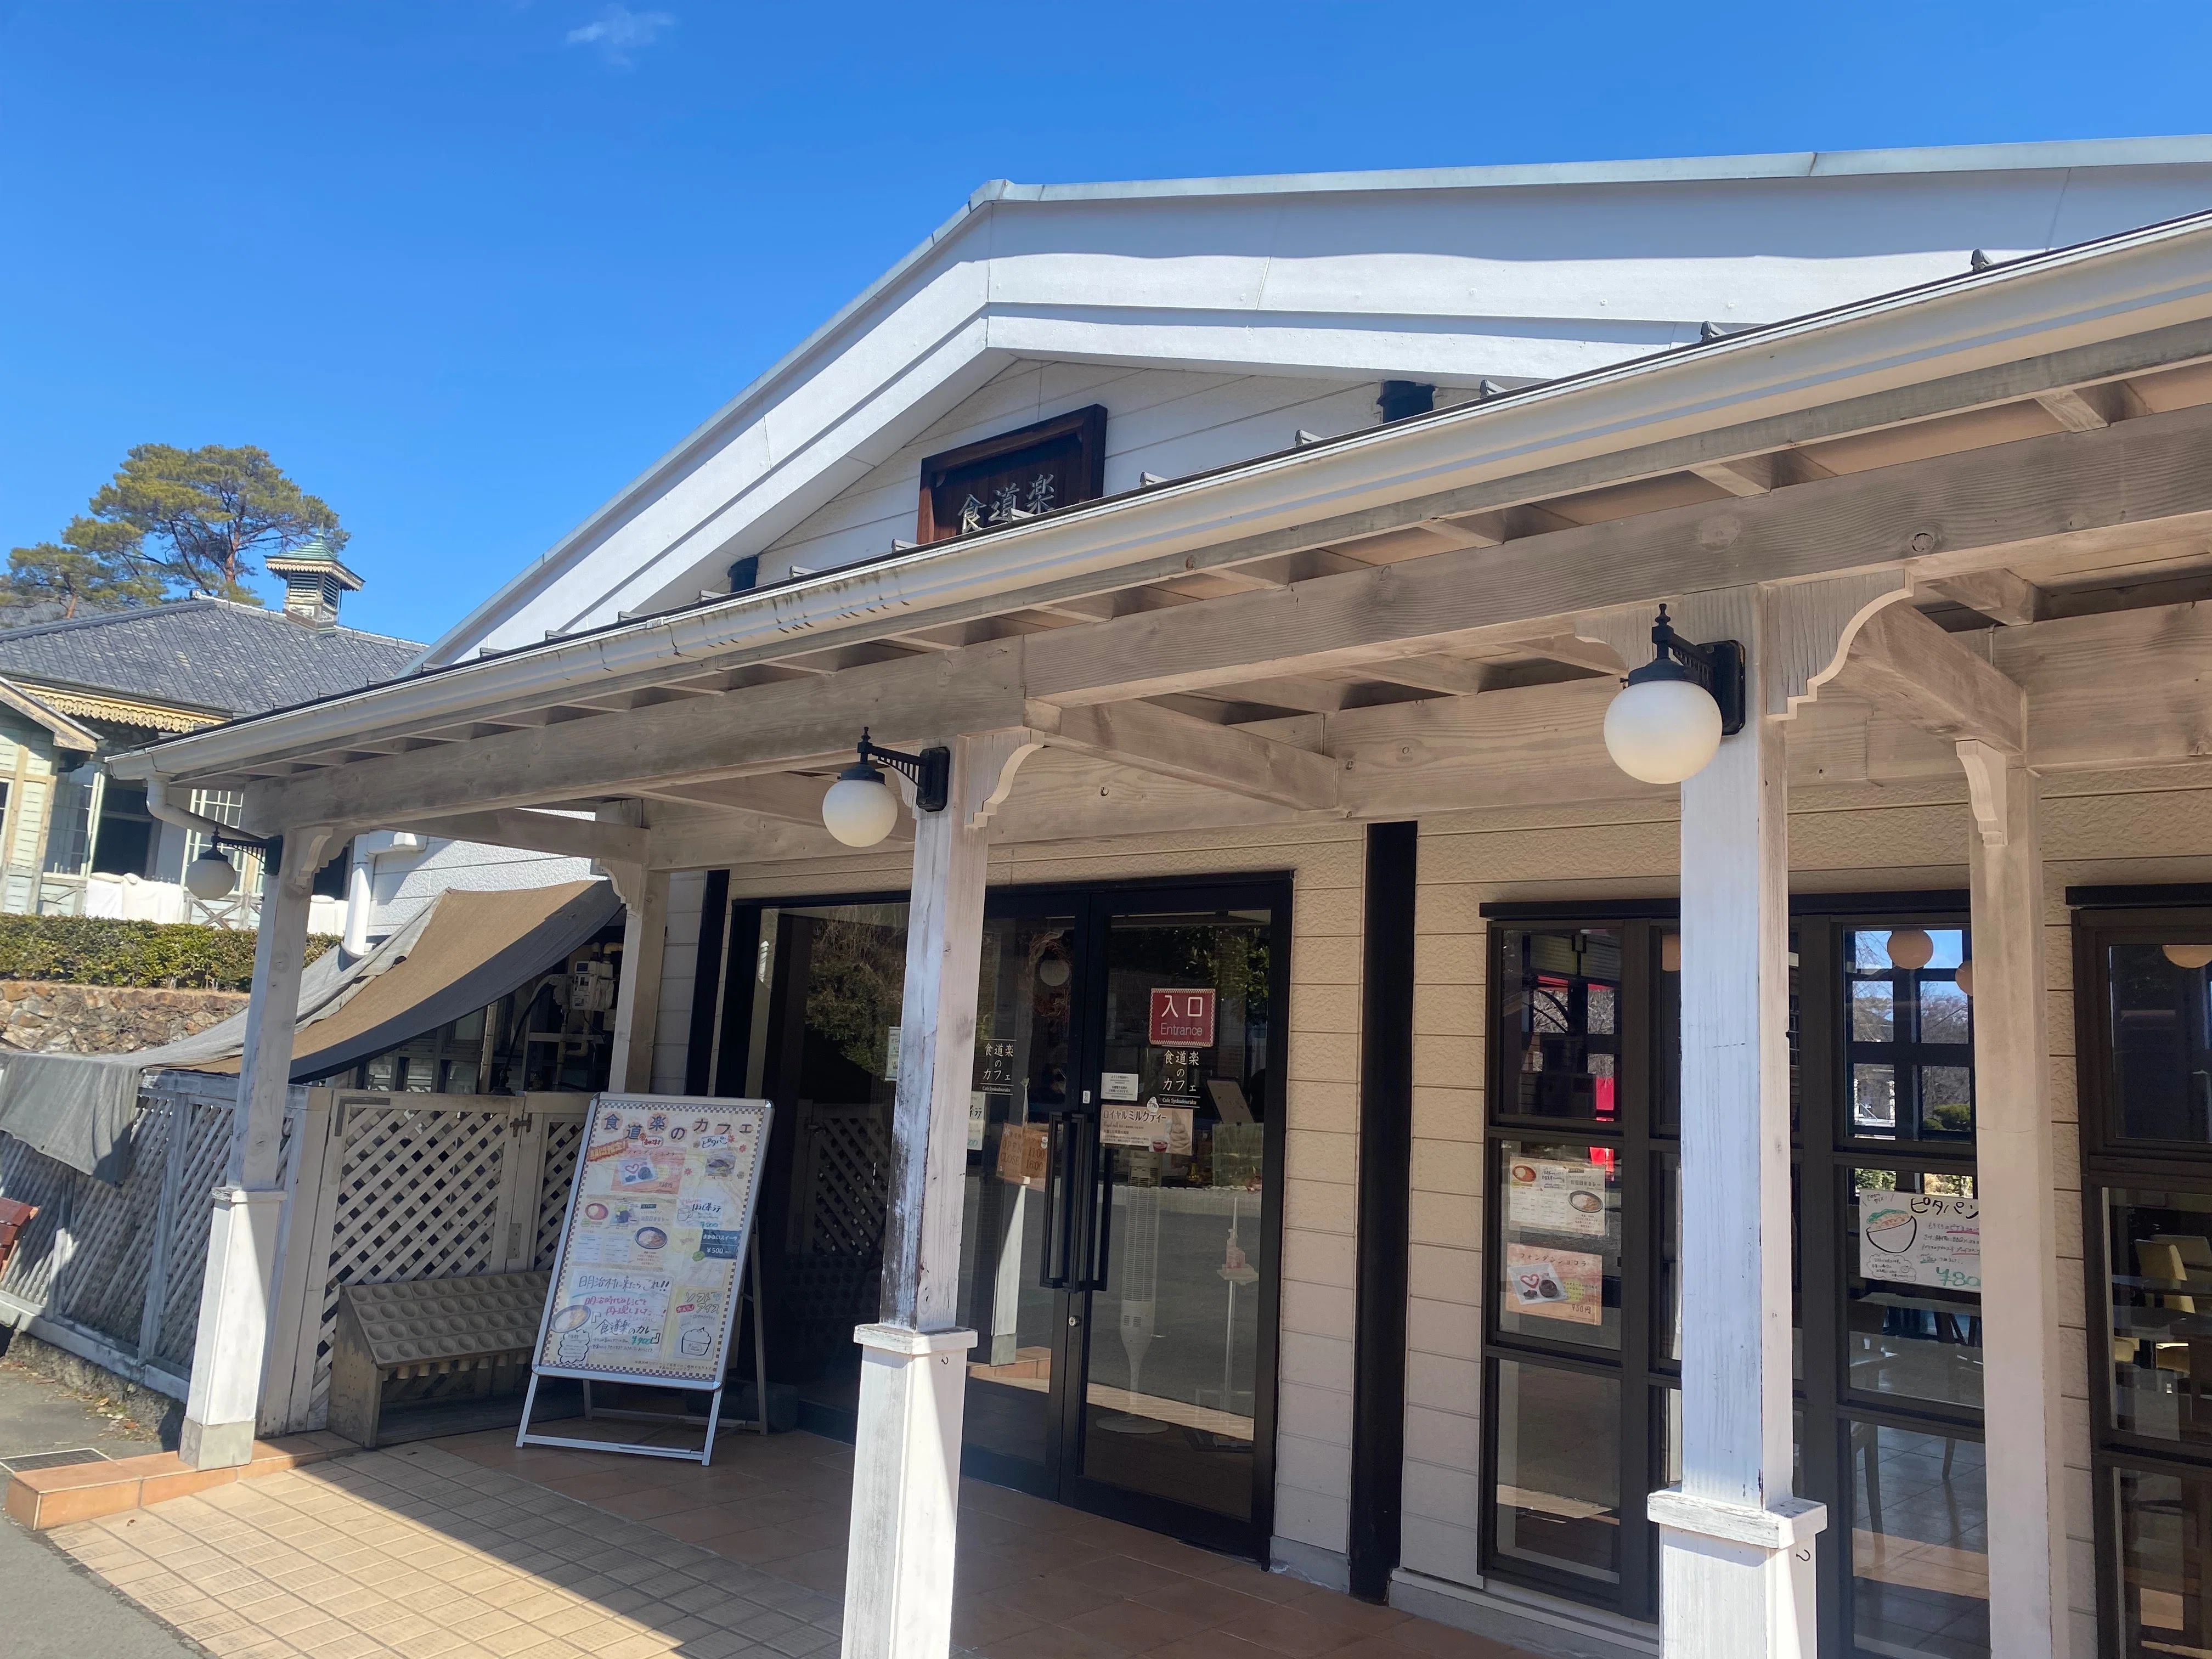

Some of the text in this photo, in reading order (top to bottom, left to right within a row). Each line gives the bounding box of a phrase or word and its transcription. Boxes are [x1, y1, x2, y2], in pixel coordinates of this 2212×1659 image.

[957, 473, 1055, 534] 食道楽
[1161, 995, 1203, 1018] 入口
[1160, 1023, 1203, 1036] Entrance
[984, 1043, 1014, 1057] 食道楽
[994, 1059, 1002, 1068] の
[1164, 1049, 1199, 1066] 食道楽
[983, 1068, 1011, 1081] カフェ
[1176, 1069, 1185, 1077] の
[1163, 1077, 1197, 1092] カフェ
[1103, 1109, 1167, 1124] ロイヤルミルクティー
[603, 1113, 753, 1141] 食道楽のカフェ
[1002, 1138, 1022, 1153] OPEN
[1000, 1152, 1020, 1166] CLOSE
[1911, 1197, 1979, 1220] ピタパン
[1520, 1252, 1587, 1267] フォンダンショコラ
[686, 1291, 710, 1303] ソフト
[696, 1303, 719, 1314] アイス
[1571, 1303, 1592, 1314] 950円
